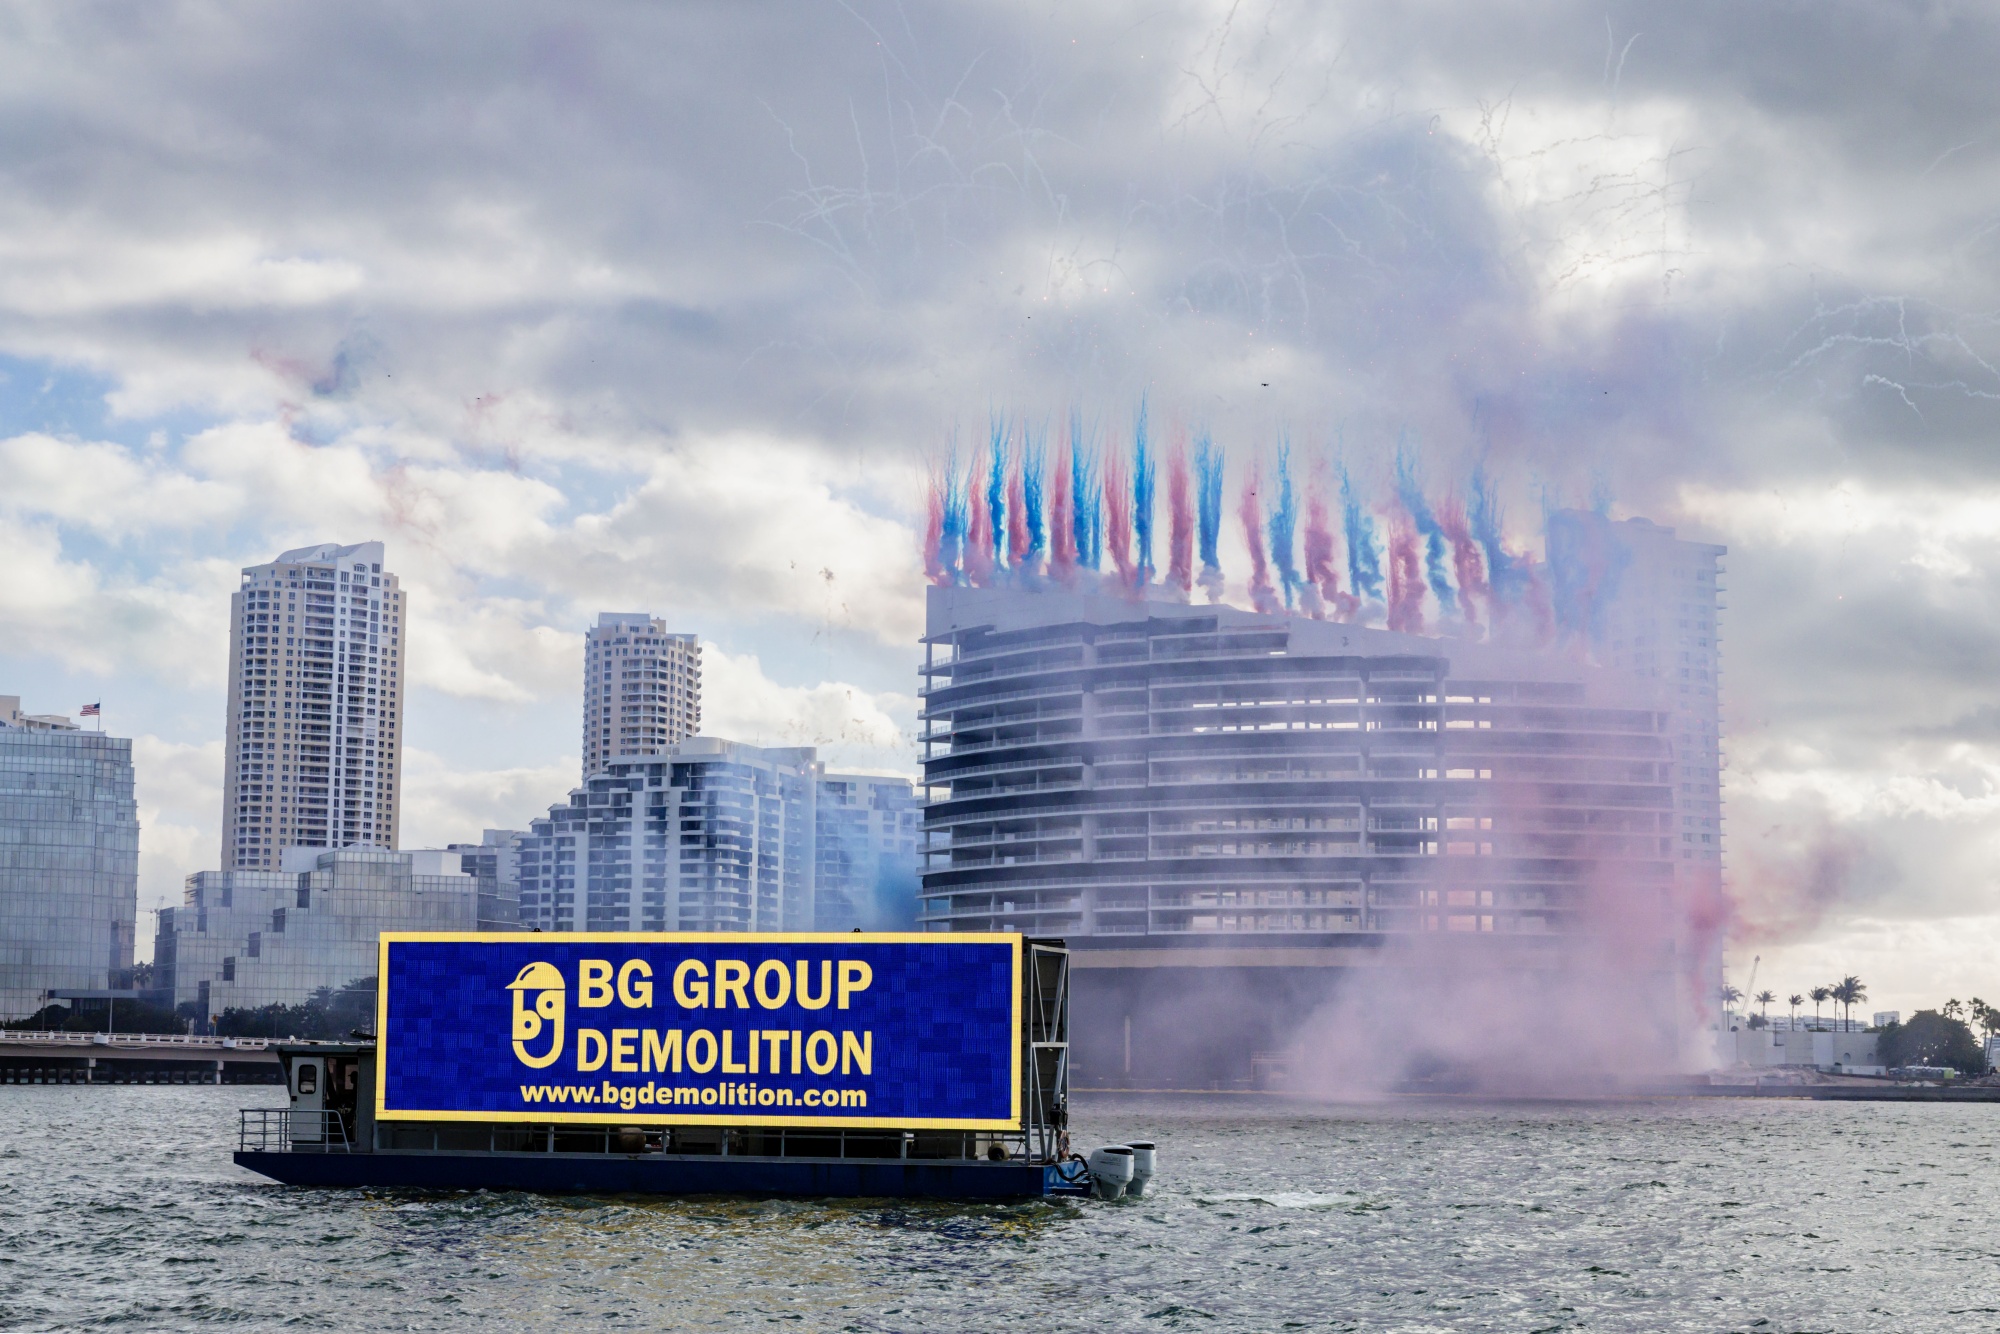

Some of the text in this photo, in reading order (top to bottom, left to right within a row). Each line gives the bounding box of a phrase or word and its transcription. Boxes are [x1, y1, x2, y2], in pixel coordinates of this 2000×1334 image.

[578, 958, 873, 1010] BG GROUP
[577, 1028, 872, 1075] DEMOLITION
[520, 1080, 867, 1110] www.bgdemolition.com
